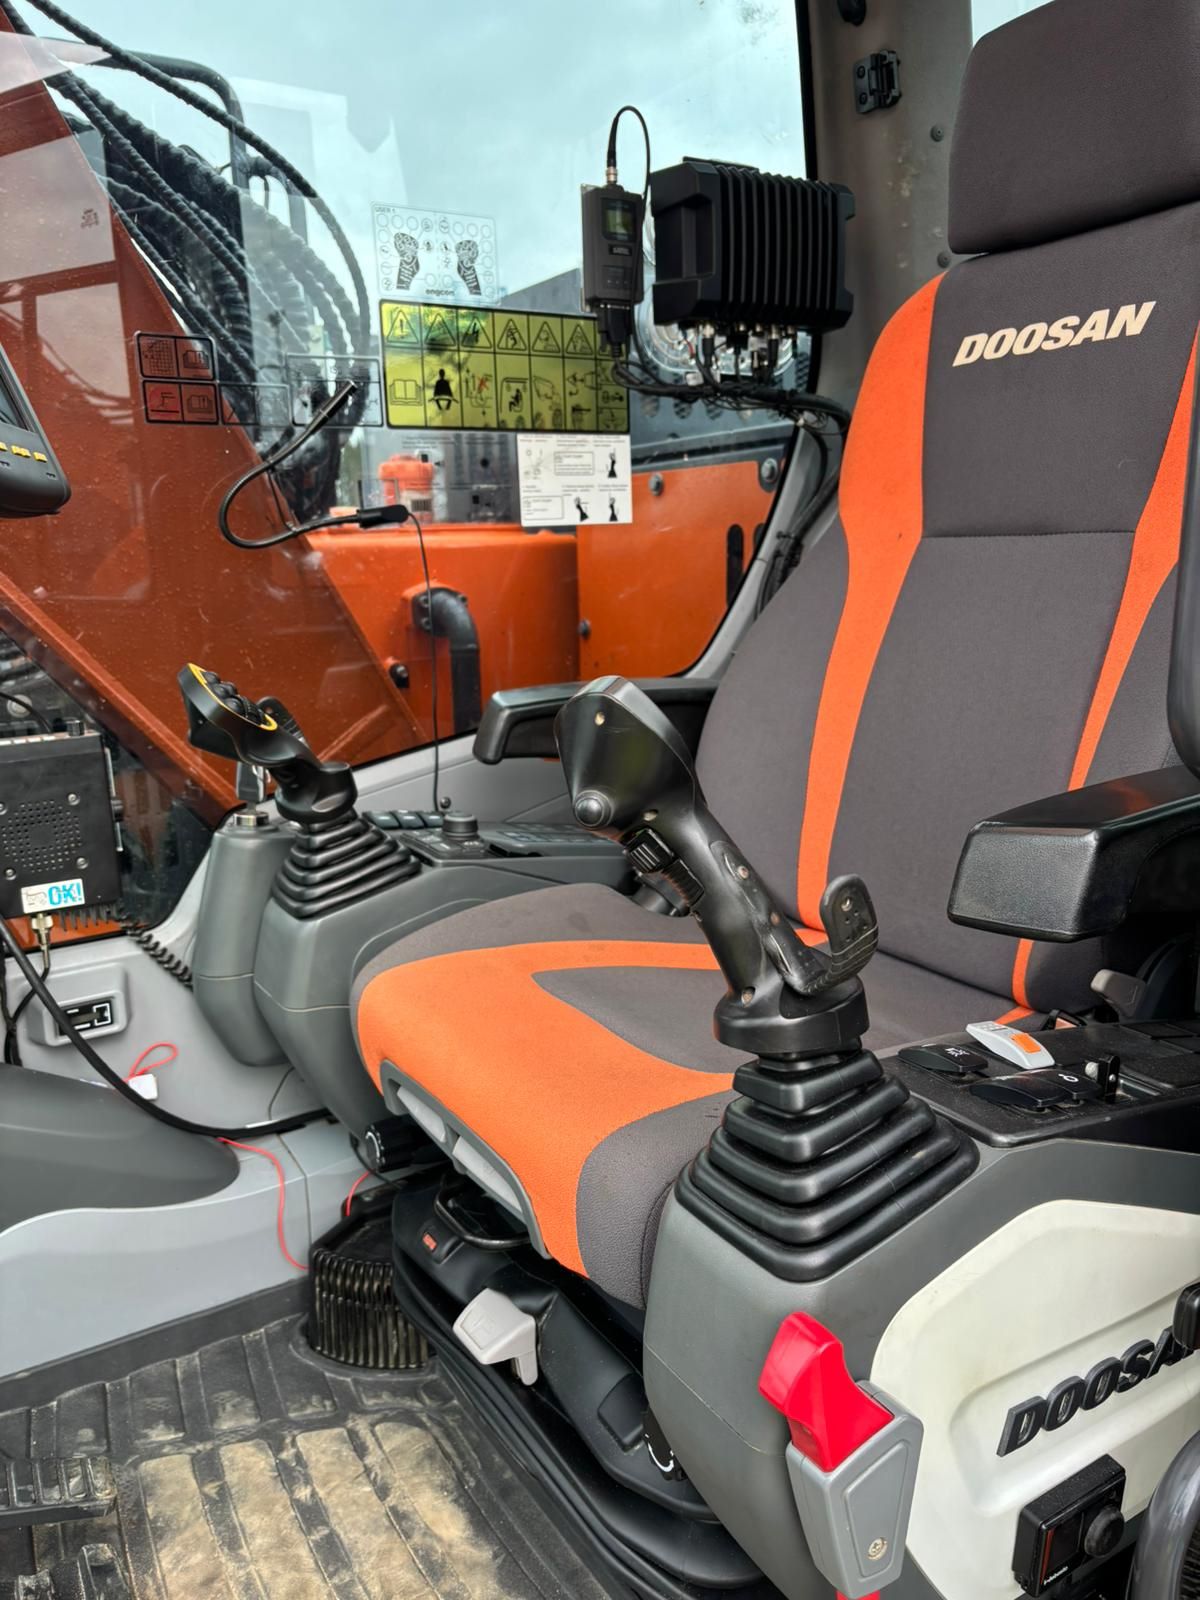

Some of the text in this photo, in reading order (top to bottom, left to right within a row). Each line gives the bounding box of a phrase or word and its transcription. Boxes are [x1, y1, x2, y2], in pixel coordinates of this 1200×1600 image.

[425, 288, 455, 296] engcon
[952, 301, 1157, 368] DOOSAN
[48, 882, 83, 906] OK!
[996, 1325, 1195, 1457] DOOSA
